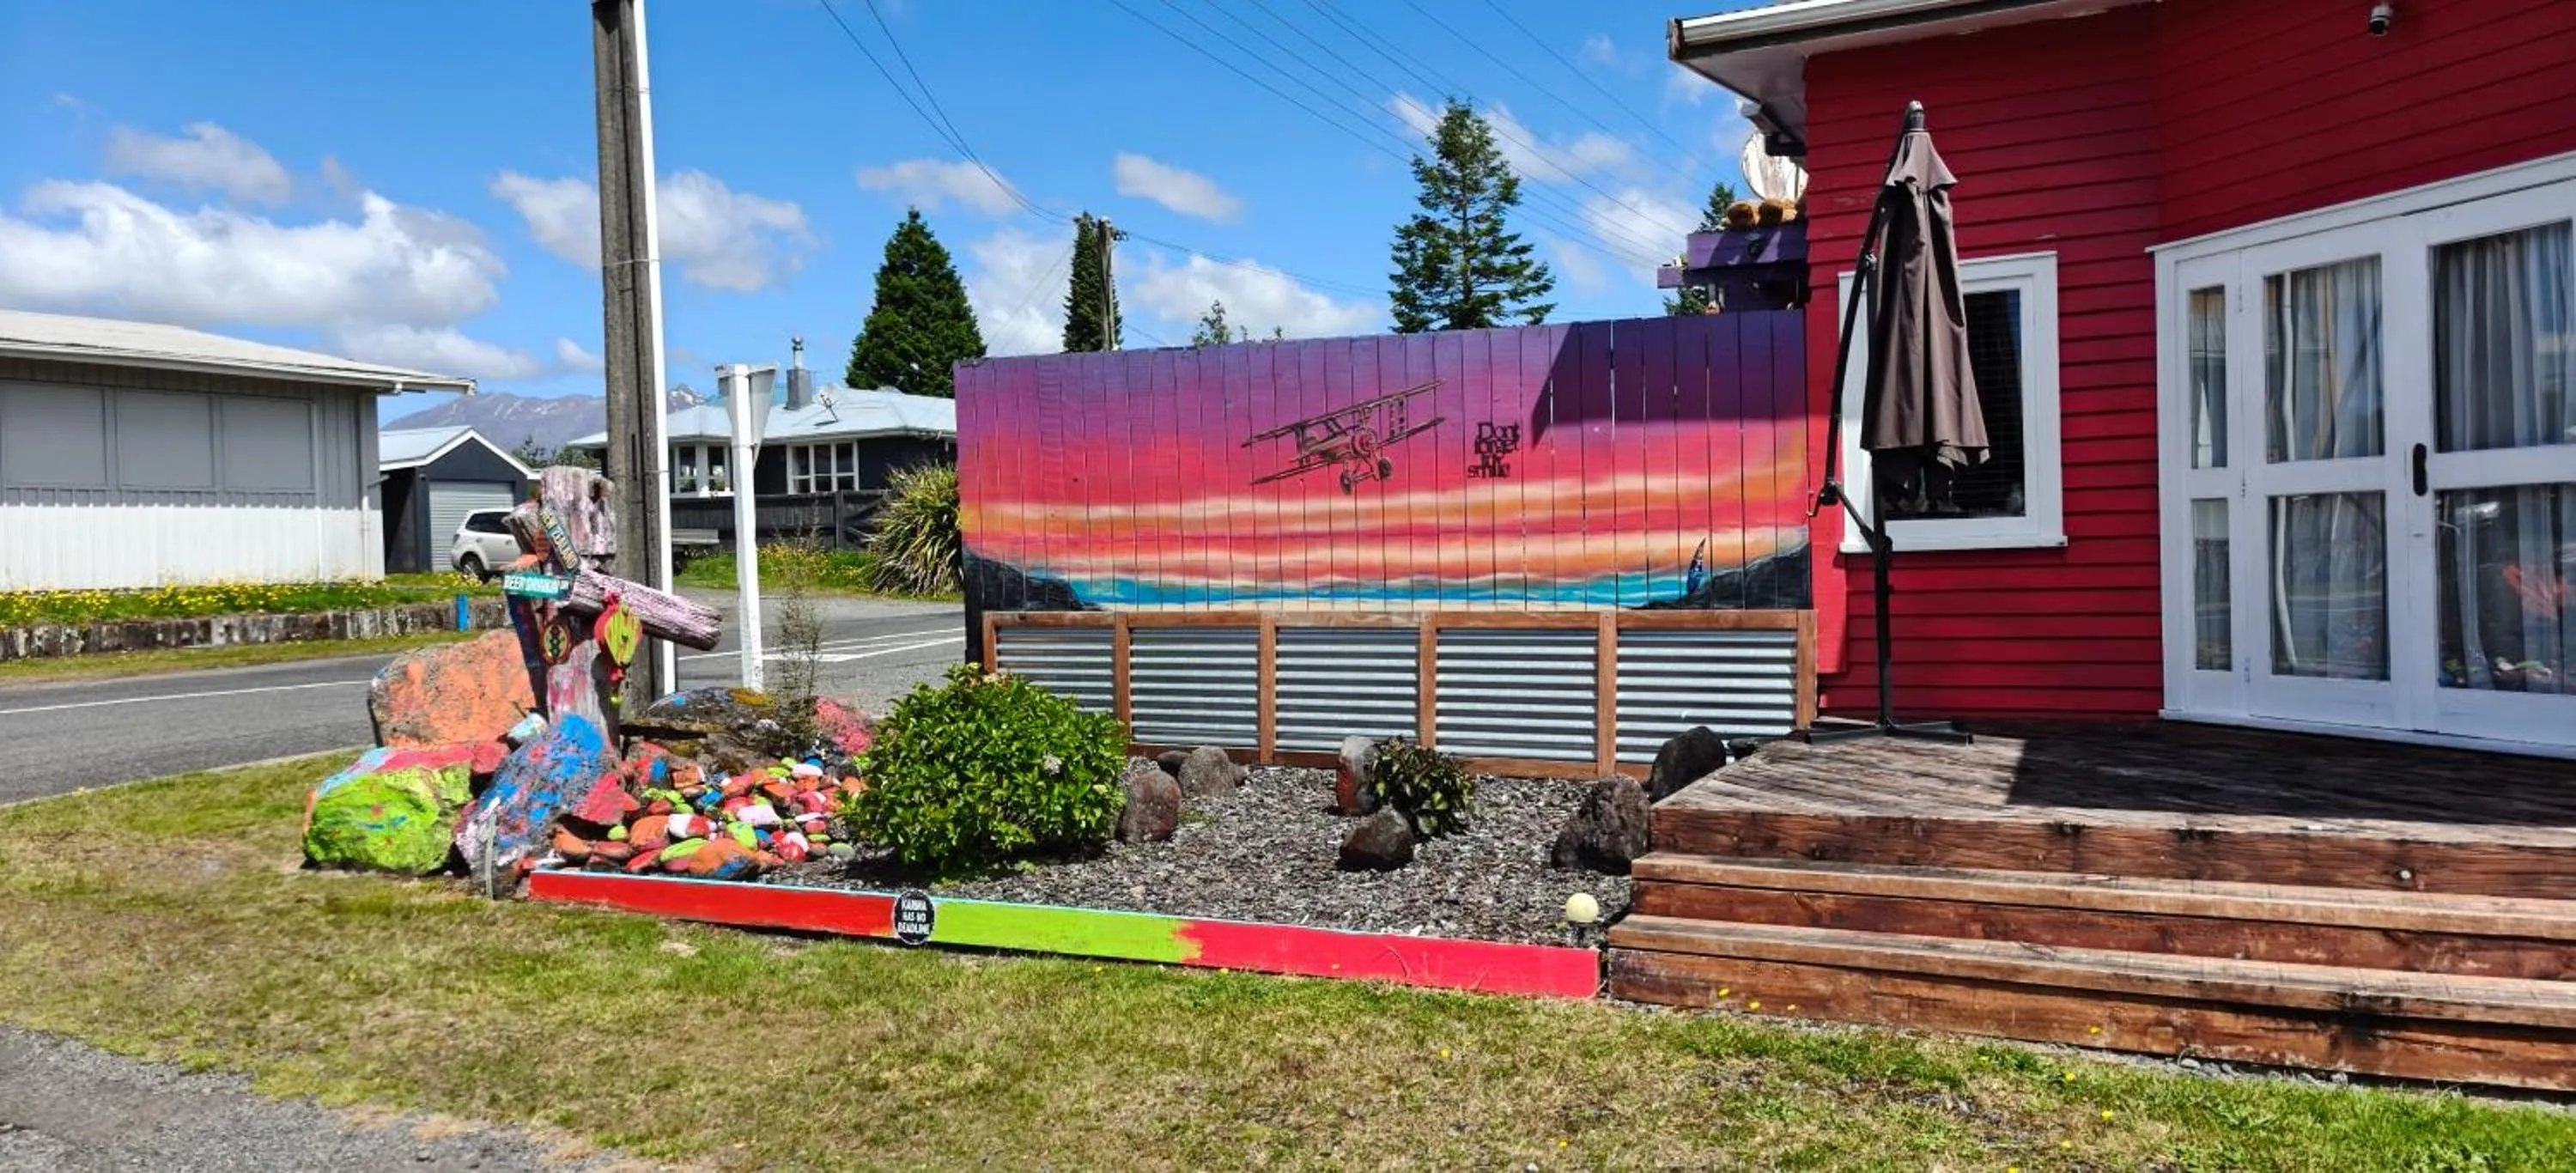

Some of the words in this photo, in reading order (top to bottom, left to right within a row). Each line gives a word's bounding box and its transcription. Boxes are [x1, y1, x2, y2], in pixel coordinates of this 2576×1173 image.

[504, 574, 525, 591] BEER
[901, 899, 927, 911] KARMA
[902, 911, 915, 921] HAS
[916, 912, 927, 922] NO
[897, 921, 930, 935] DEADLINE
